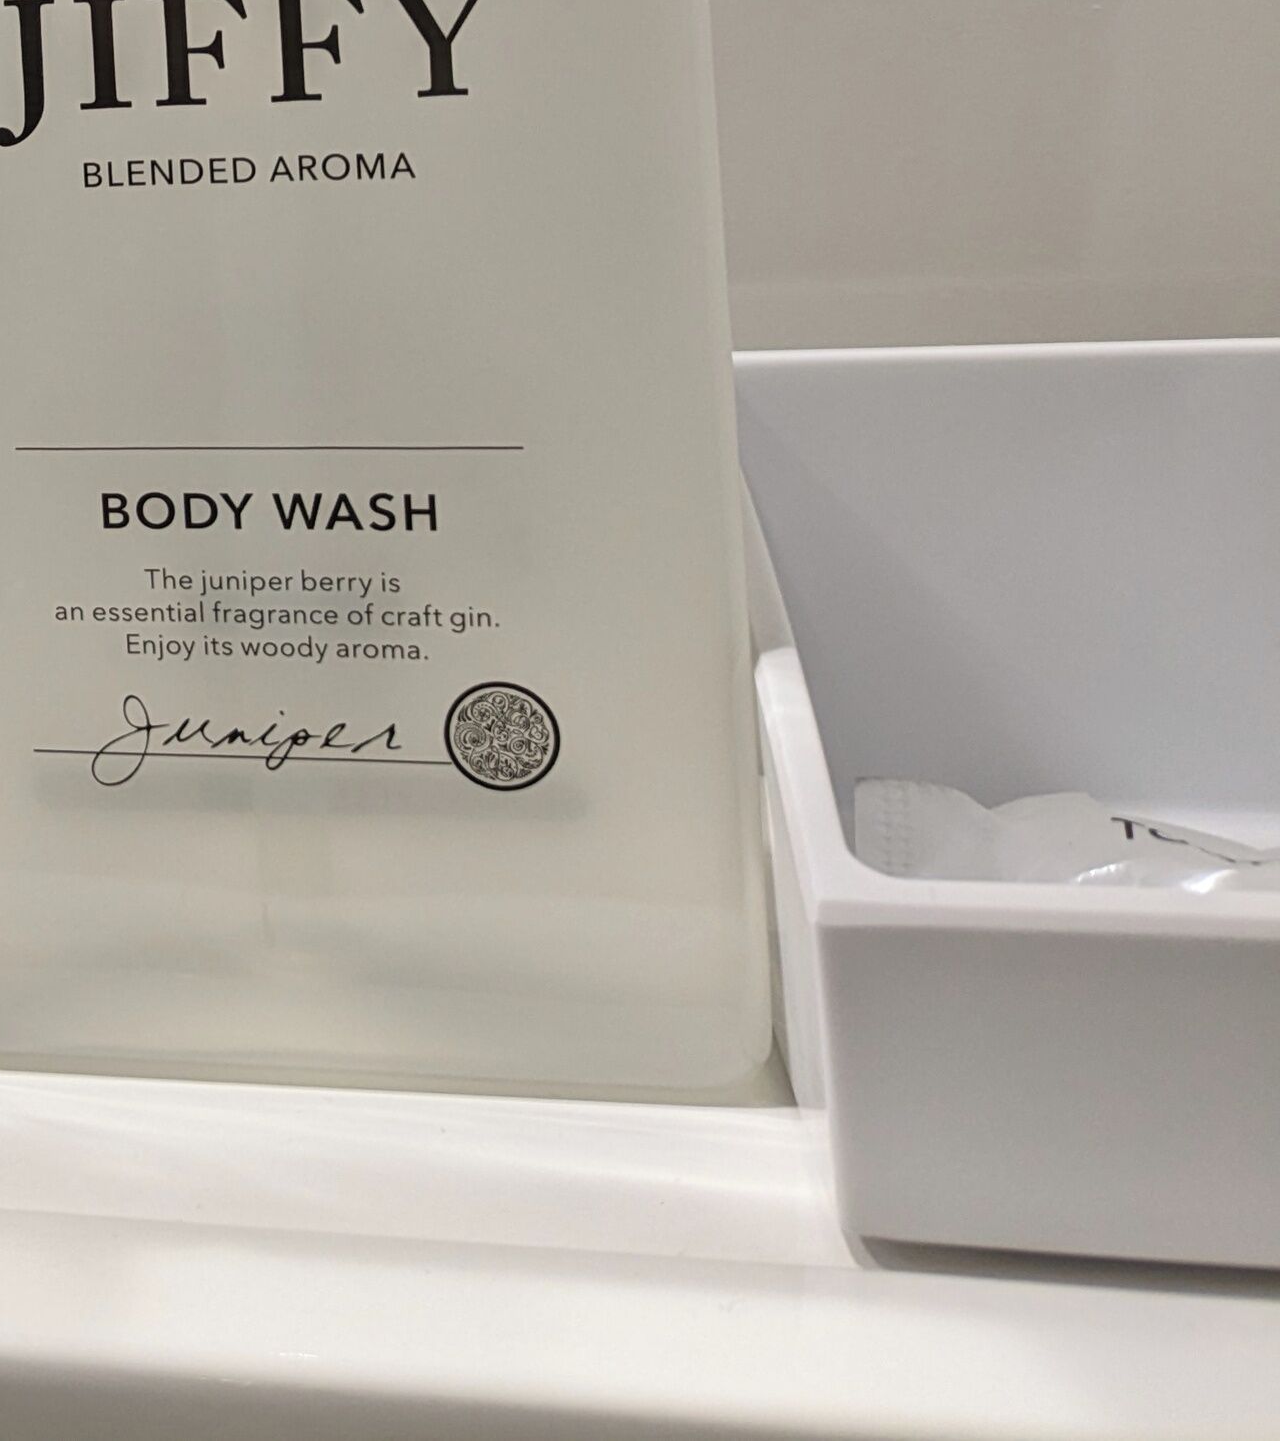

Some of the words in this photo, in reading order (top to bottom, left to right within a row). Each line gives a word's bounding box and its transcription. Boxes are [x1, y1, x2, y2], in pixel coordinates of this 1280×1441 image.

[84, 158, 256, 188] BLENDED
[270, 153, 415, 182] AROMA
[102, 492, 253, 529] BODY
[272, 493, 437, 531] WASH
[144, 568, 192, 590] The
[200, 570, 293, 597] juniper
[301, 569, 372, 598] berry
[381, 572, 400, 593] is
[55, 606, 83, 621] an
[93, 601, 204, 622] essential
[213, 601, 338, 630] fragrance
[348, 603, 374, 625] of
[381, 604, 442, 627] craft
[450, 607, 499, 633] gin.
[127, 634, 195, 661] Enjoy
[204, 635, 233, 656] its
[241, 636, 327, 664] woody
[337, 643, 428, 660] aroma.
[91, 694, 403, 786] Juniper
